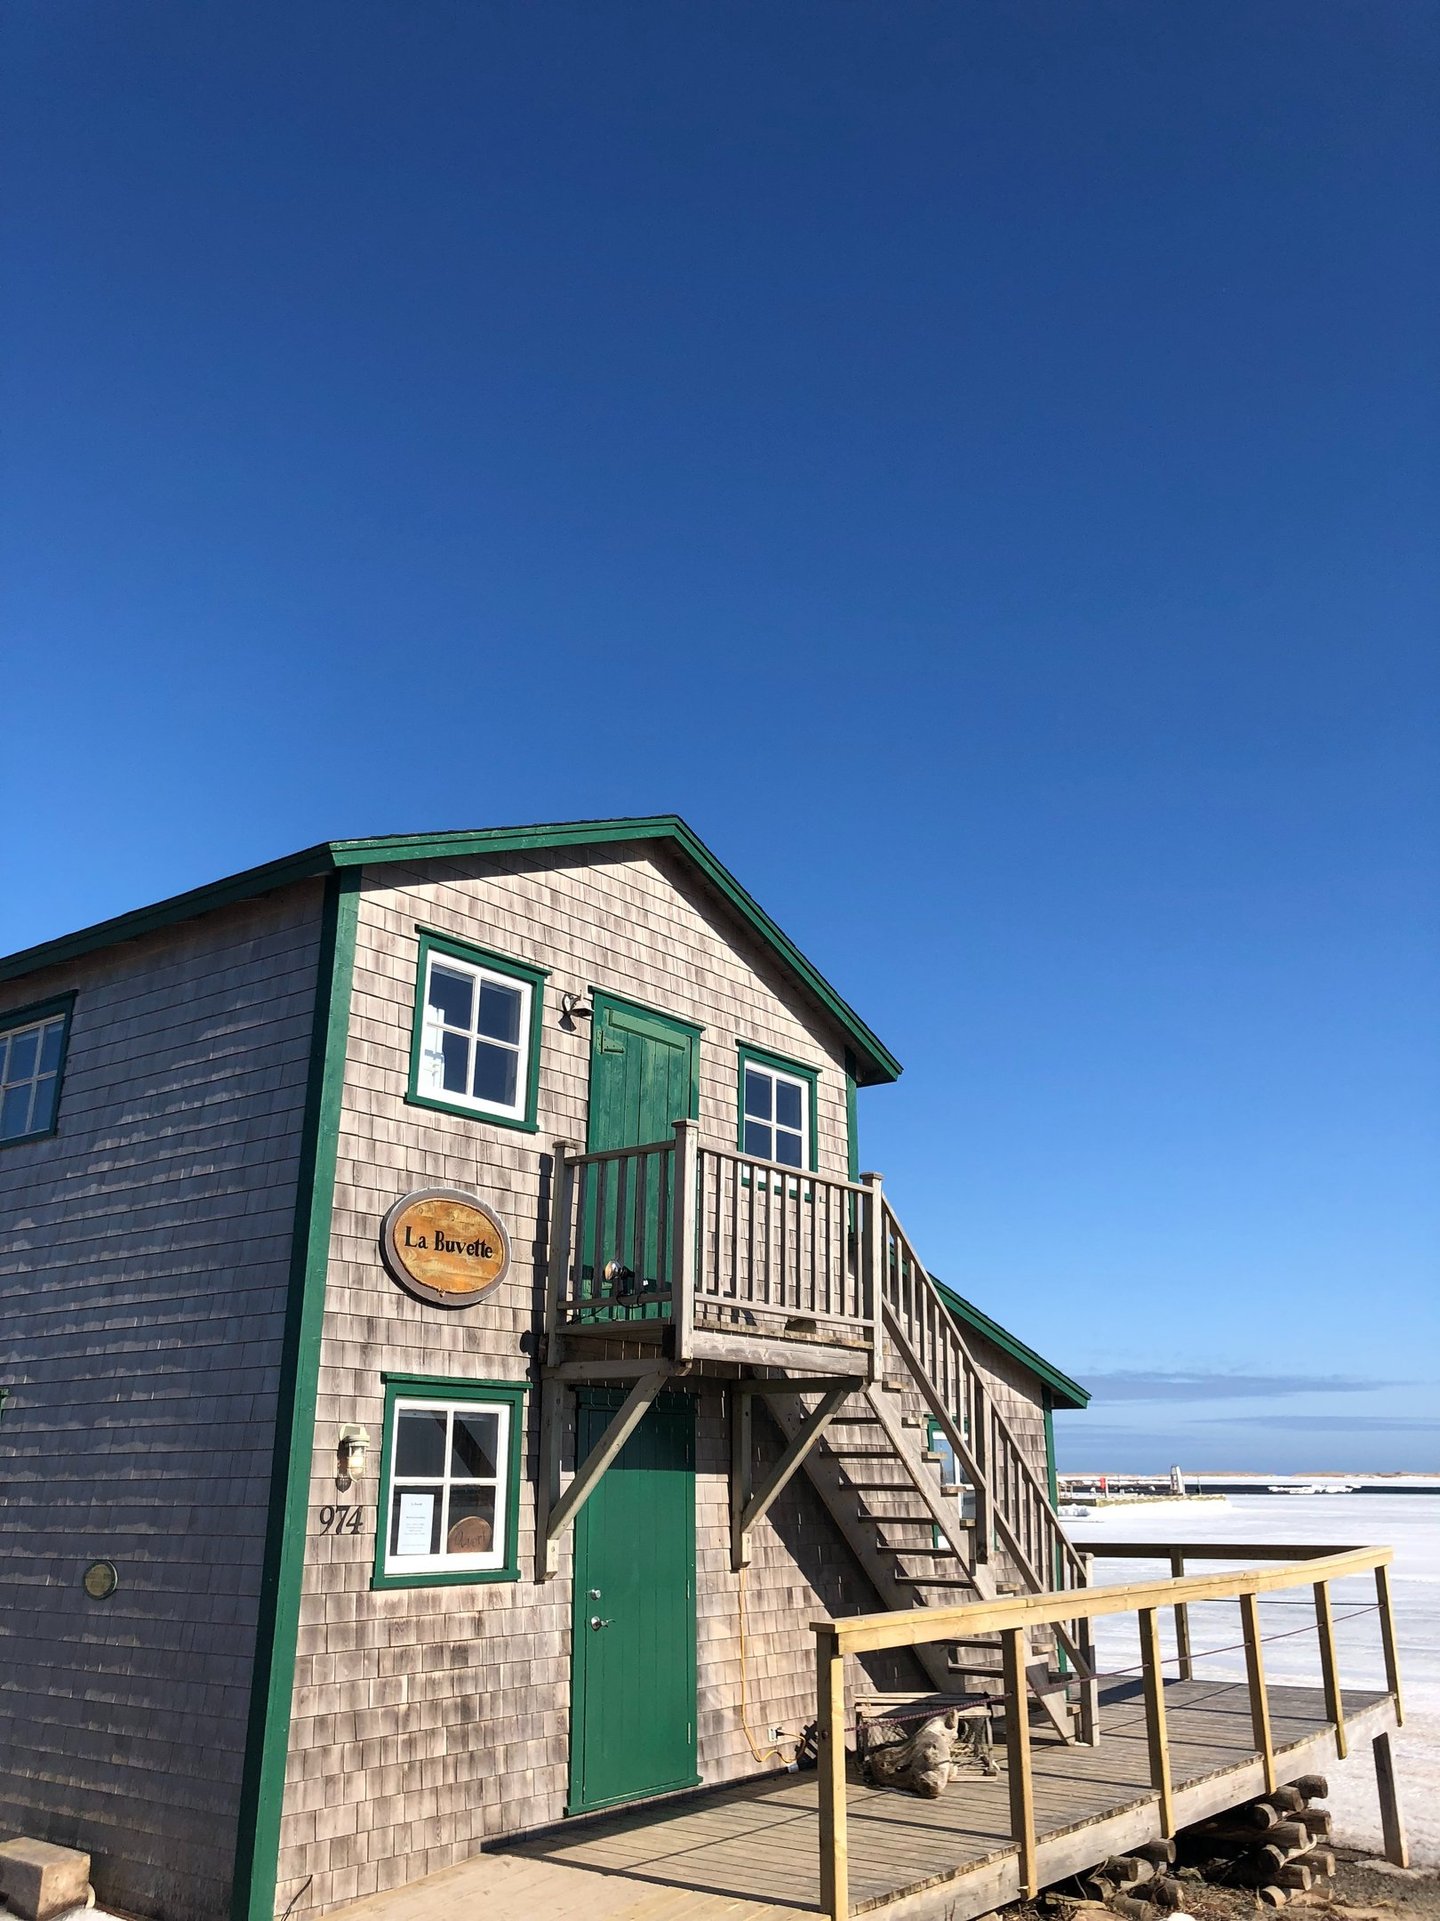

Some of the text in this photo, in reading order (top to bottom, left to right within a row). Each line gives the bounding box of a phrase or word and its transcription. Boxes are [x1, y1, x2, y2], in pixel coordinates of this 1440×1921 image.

[404, 1226, 493, 1259] La Buvette
[319, 1505, 364, 1537] 974
